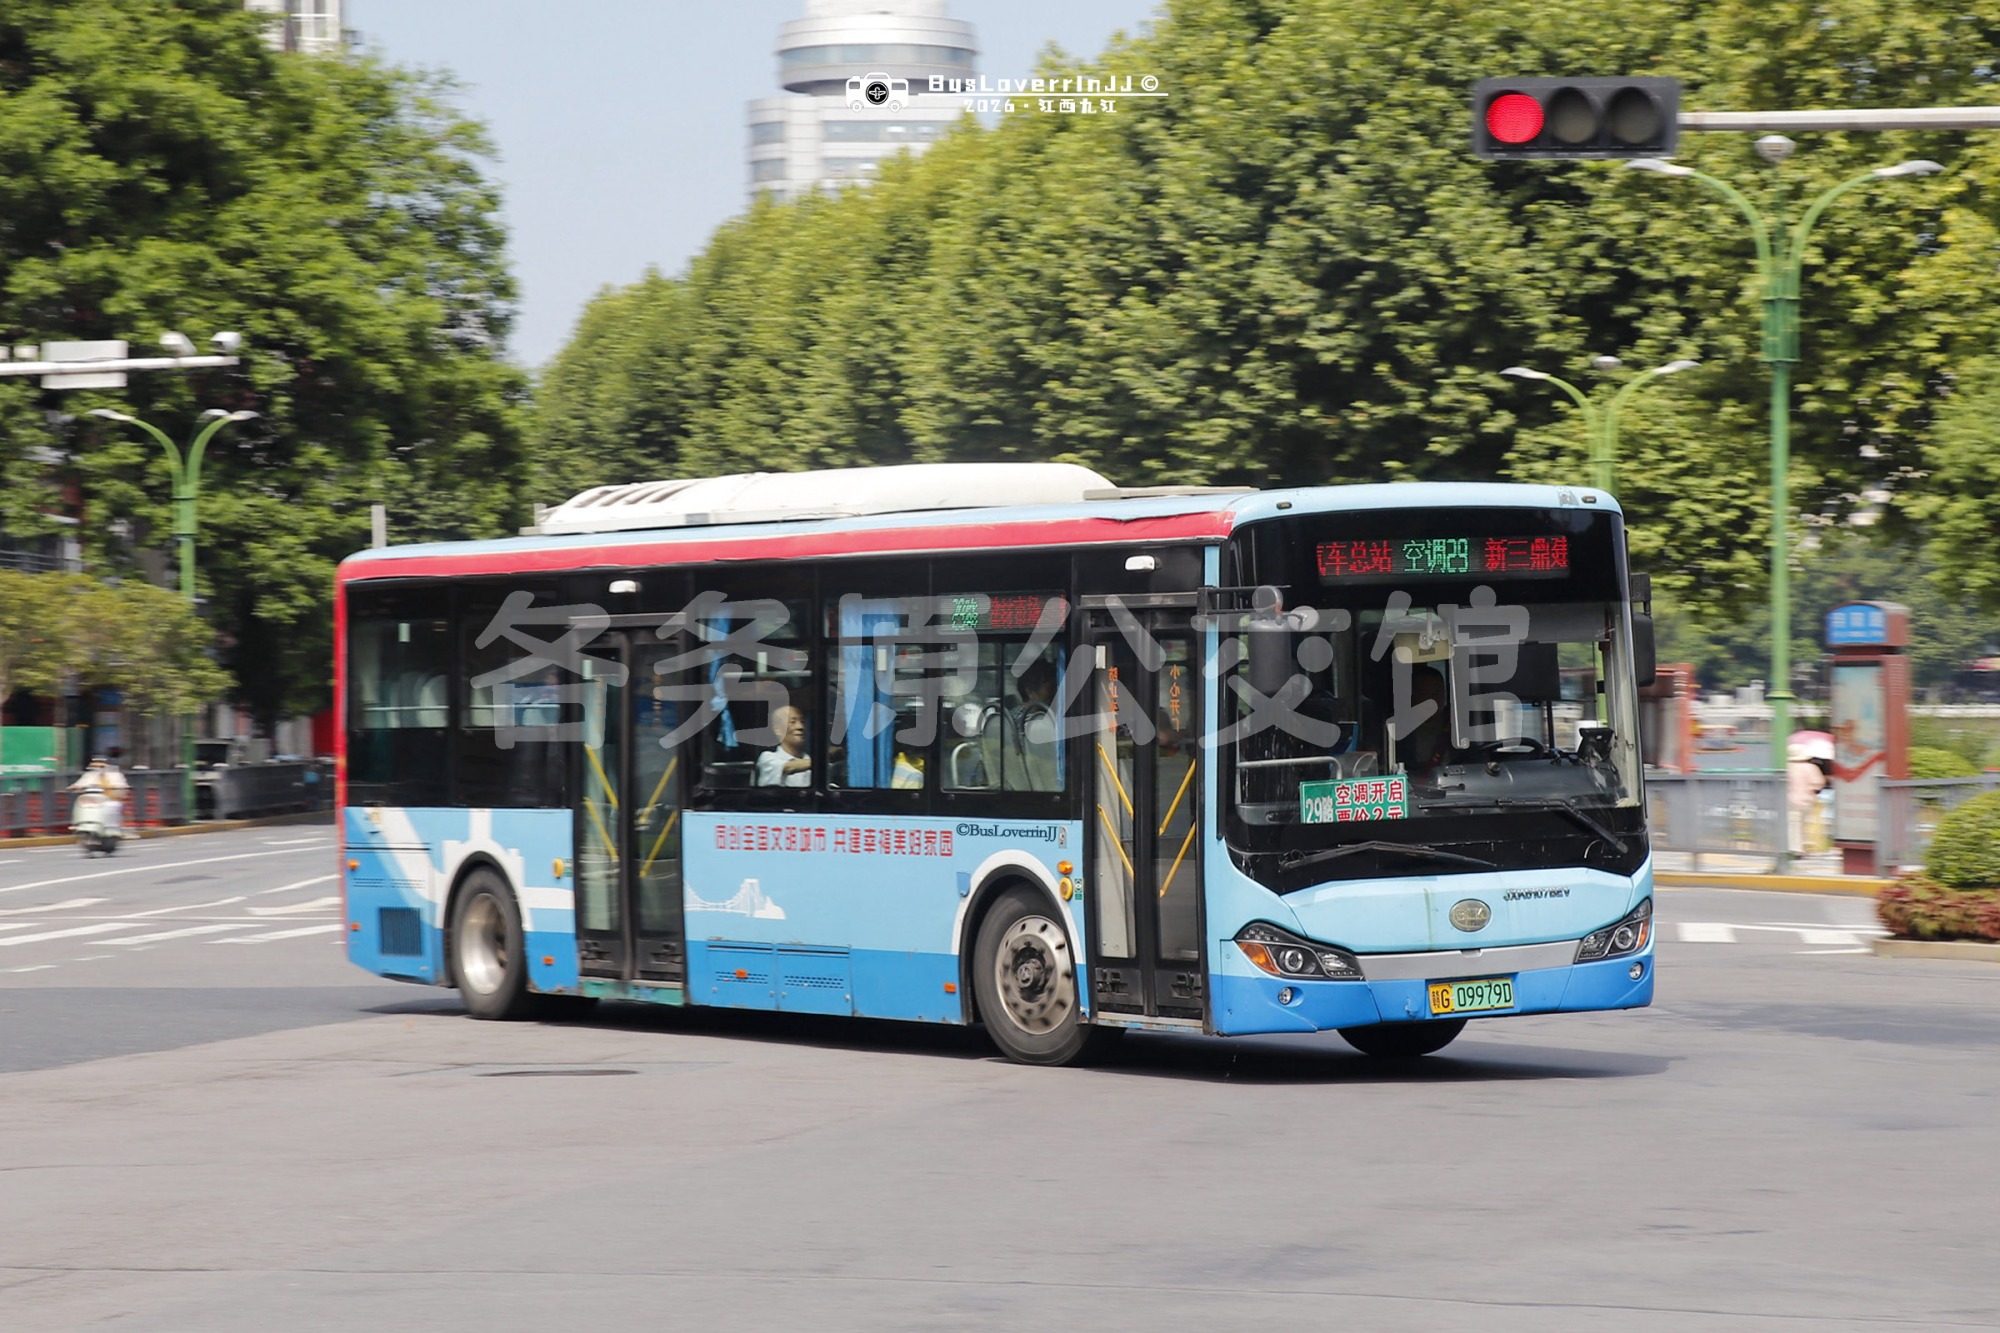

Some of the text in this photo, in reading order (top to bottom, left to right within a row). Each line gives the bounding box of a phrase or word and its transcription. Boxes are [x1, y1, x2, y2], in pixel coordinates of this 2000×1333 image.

[1402, 537, 1469, 573] 空调29
[1335, 779, 1404, 805] 空调开启
[833, 828, 953, 857] 共建幸福美好家园
[1457, 982, 1512, 1007] 09979D
